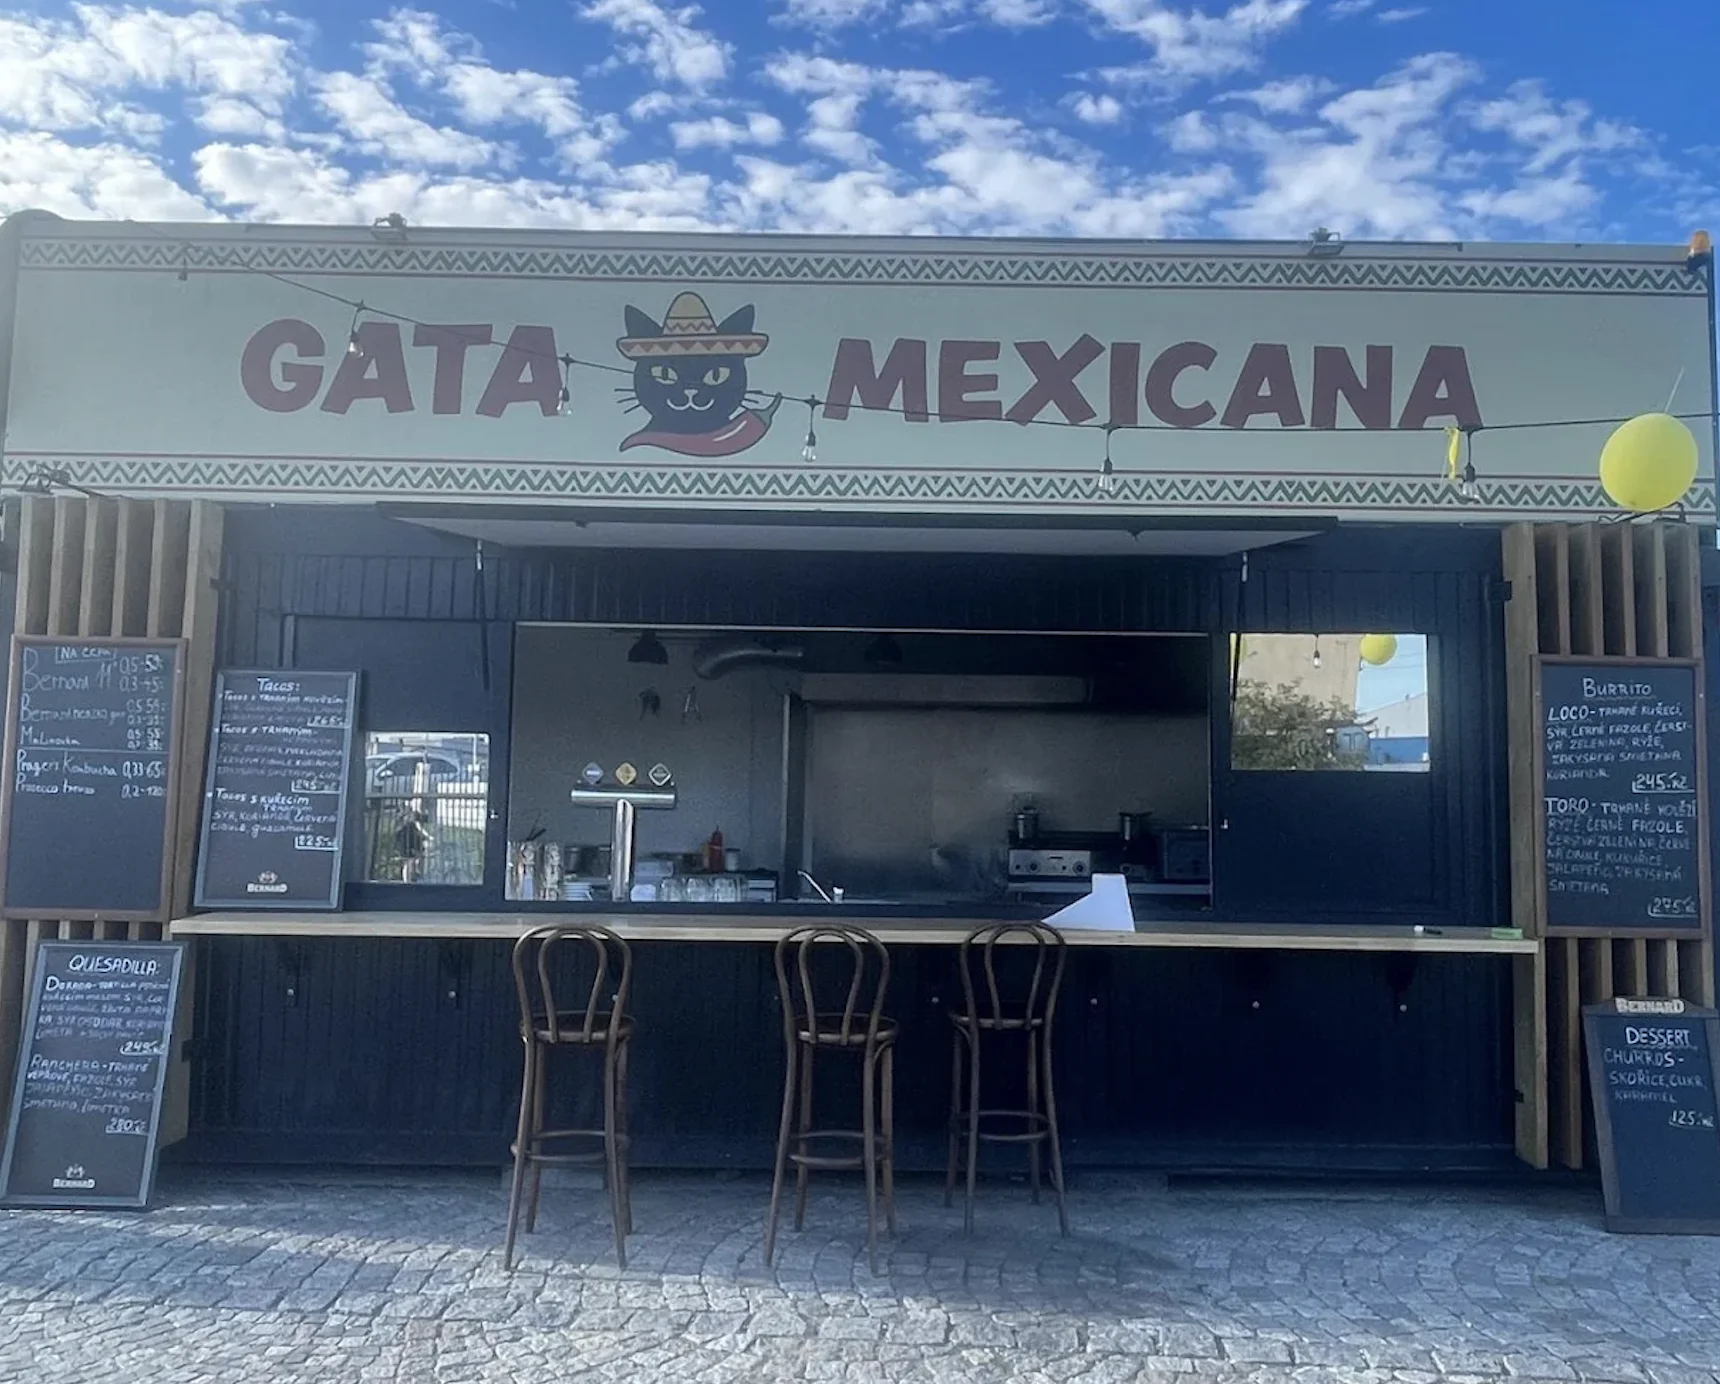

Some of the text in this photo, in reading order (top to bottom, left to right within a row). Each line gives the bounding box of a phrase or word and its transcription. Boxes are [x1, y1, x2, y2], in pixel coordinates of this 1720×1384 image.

[240, 318, 1483, 429] GATA MEXICANA
[1625, 1027, 1690, 1046] DESSERT
